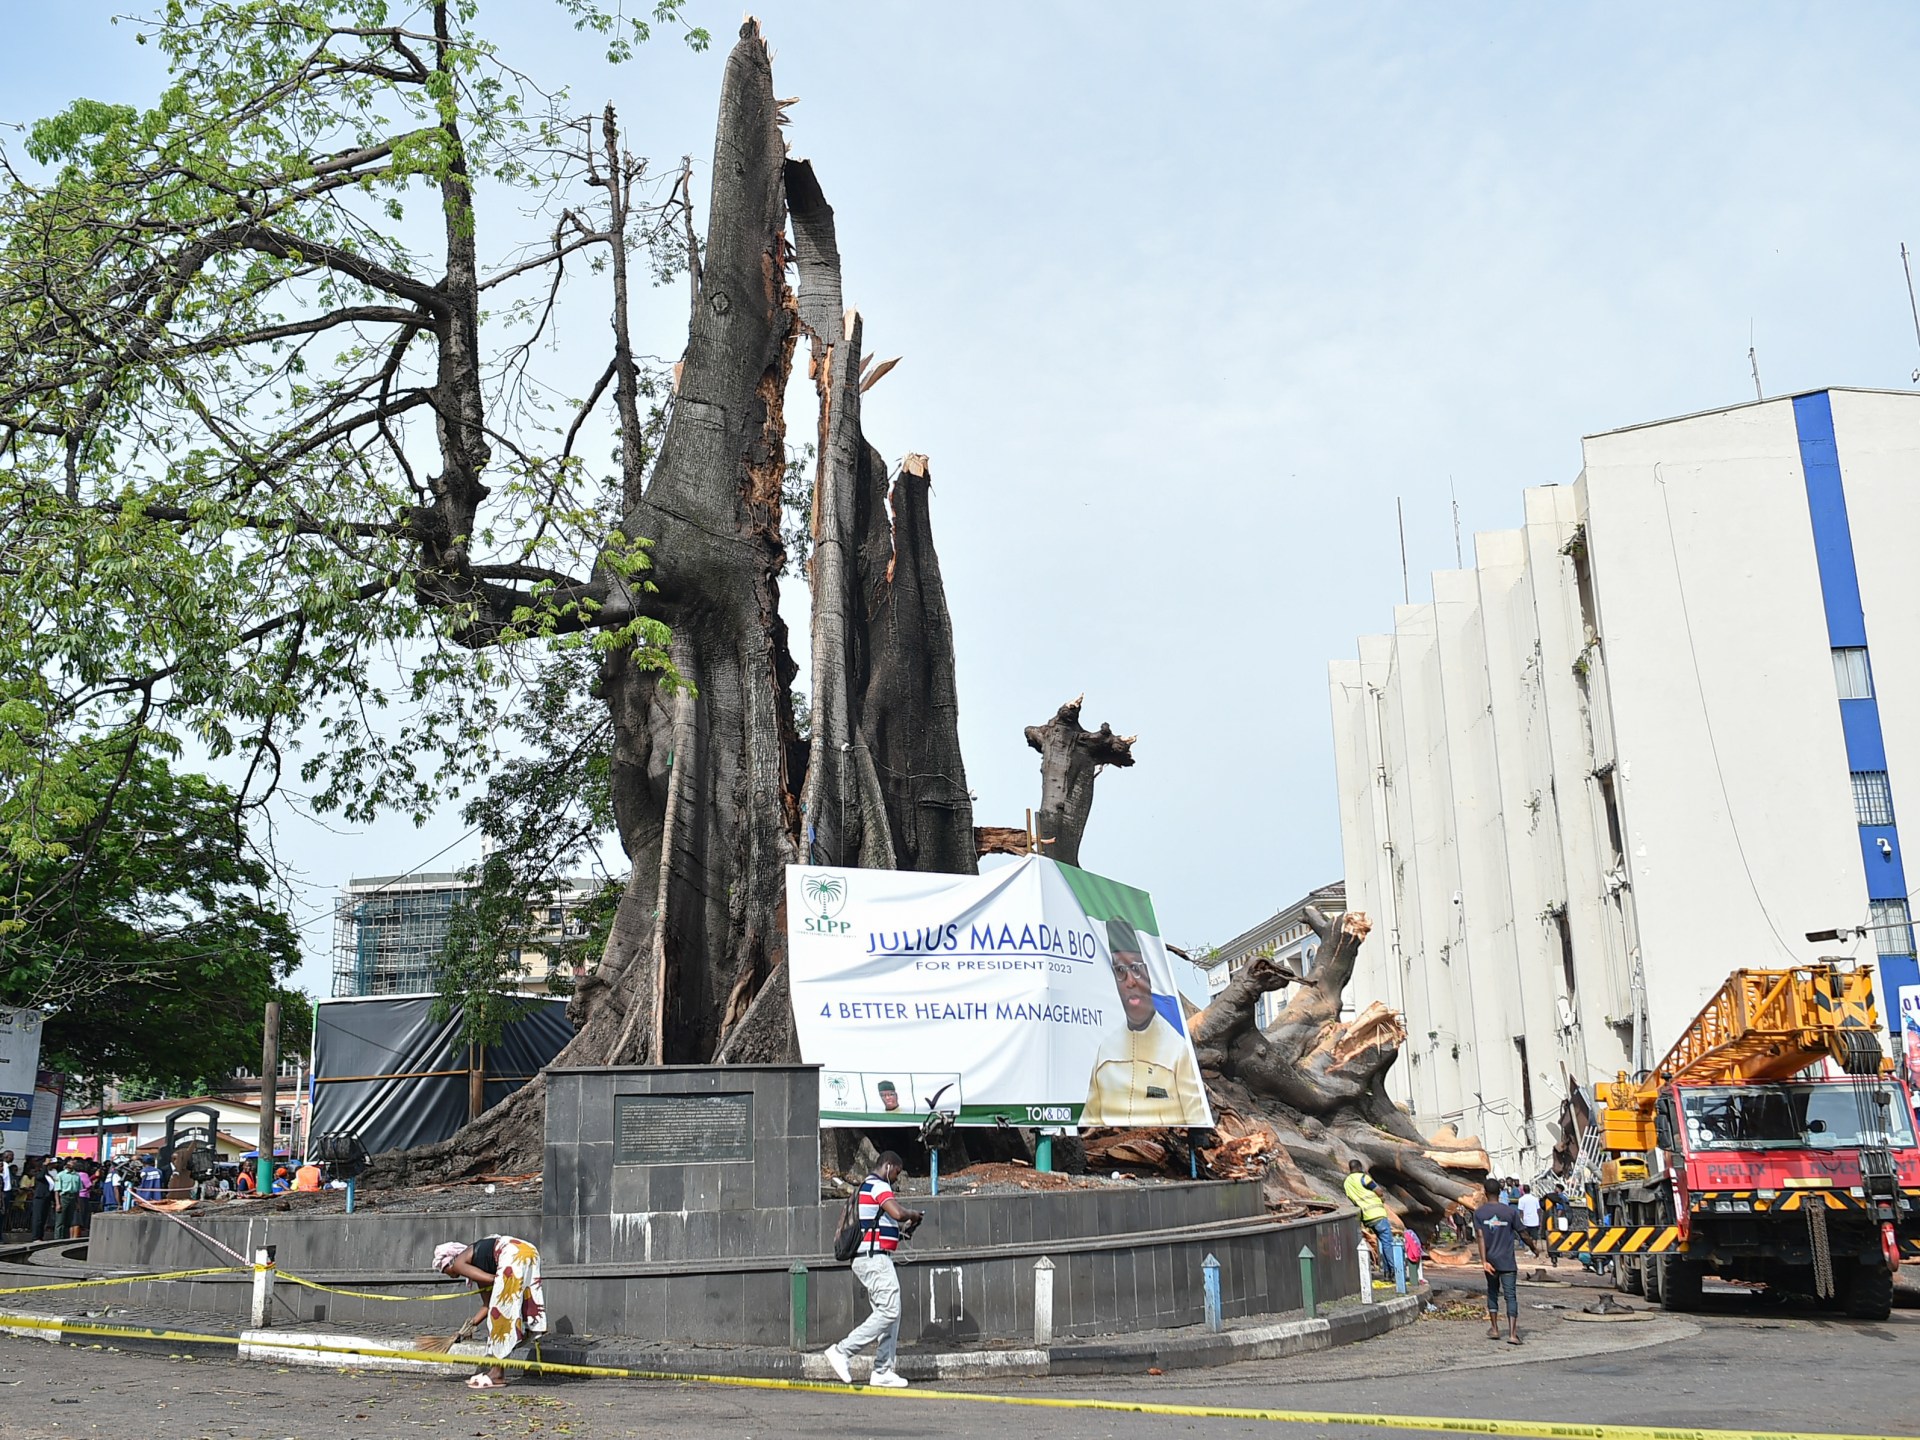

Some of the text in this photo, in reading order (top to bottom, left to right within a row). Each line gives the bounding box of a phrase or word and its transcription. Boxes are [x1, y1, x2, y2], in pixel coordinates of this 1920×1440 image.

[804, 917, 851, 934] SLPP
[866, 922, 1096, 959] JULIUS MAADA BIO
[916, 960, 1072, 974] FOR PRESIDENT 2023
[820, 1002, 1103, 1027] 4 BETTER HEALTH MANAGEMENT
[1707, 1163, 1766, 1177] PHELIX
